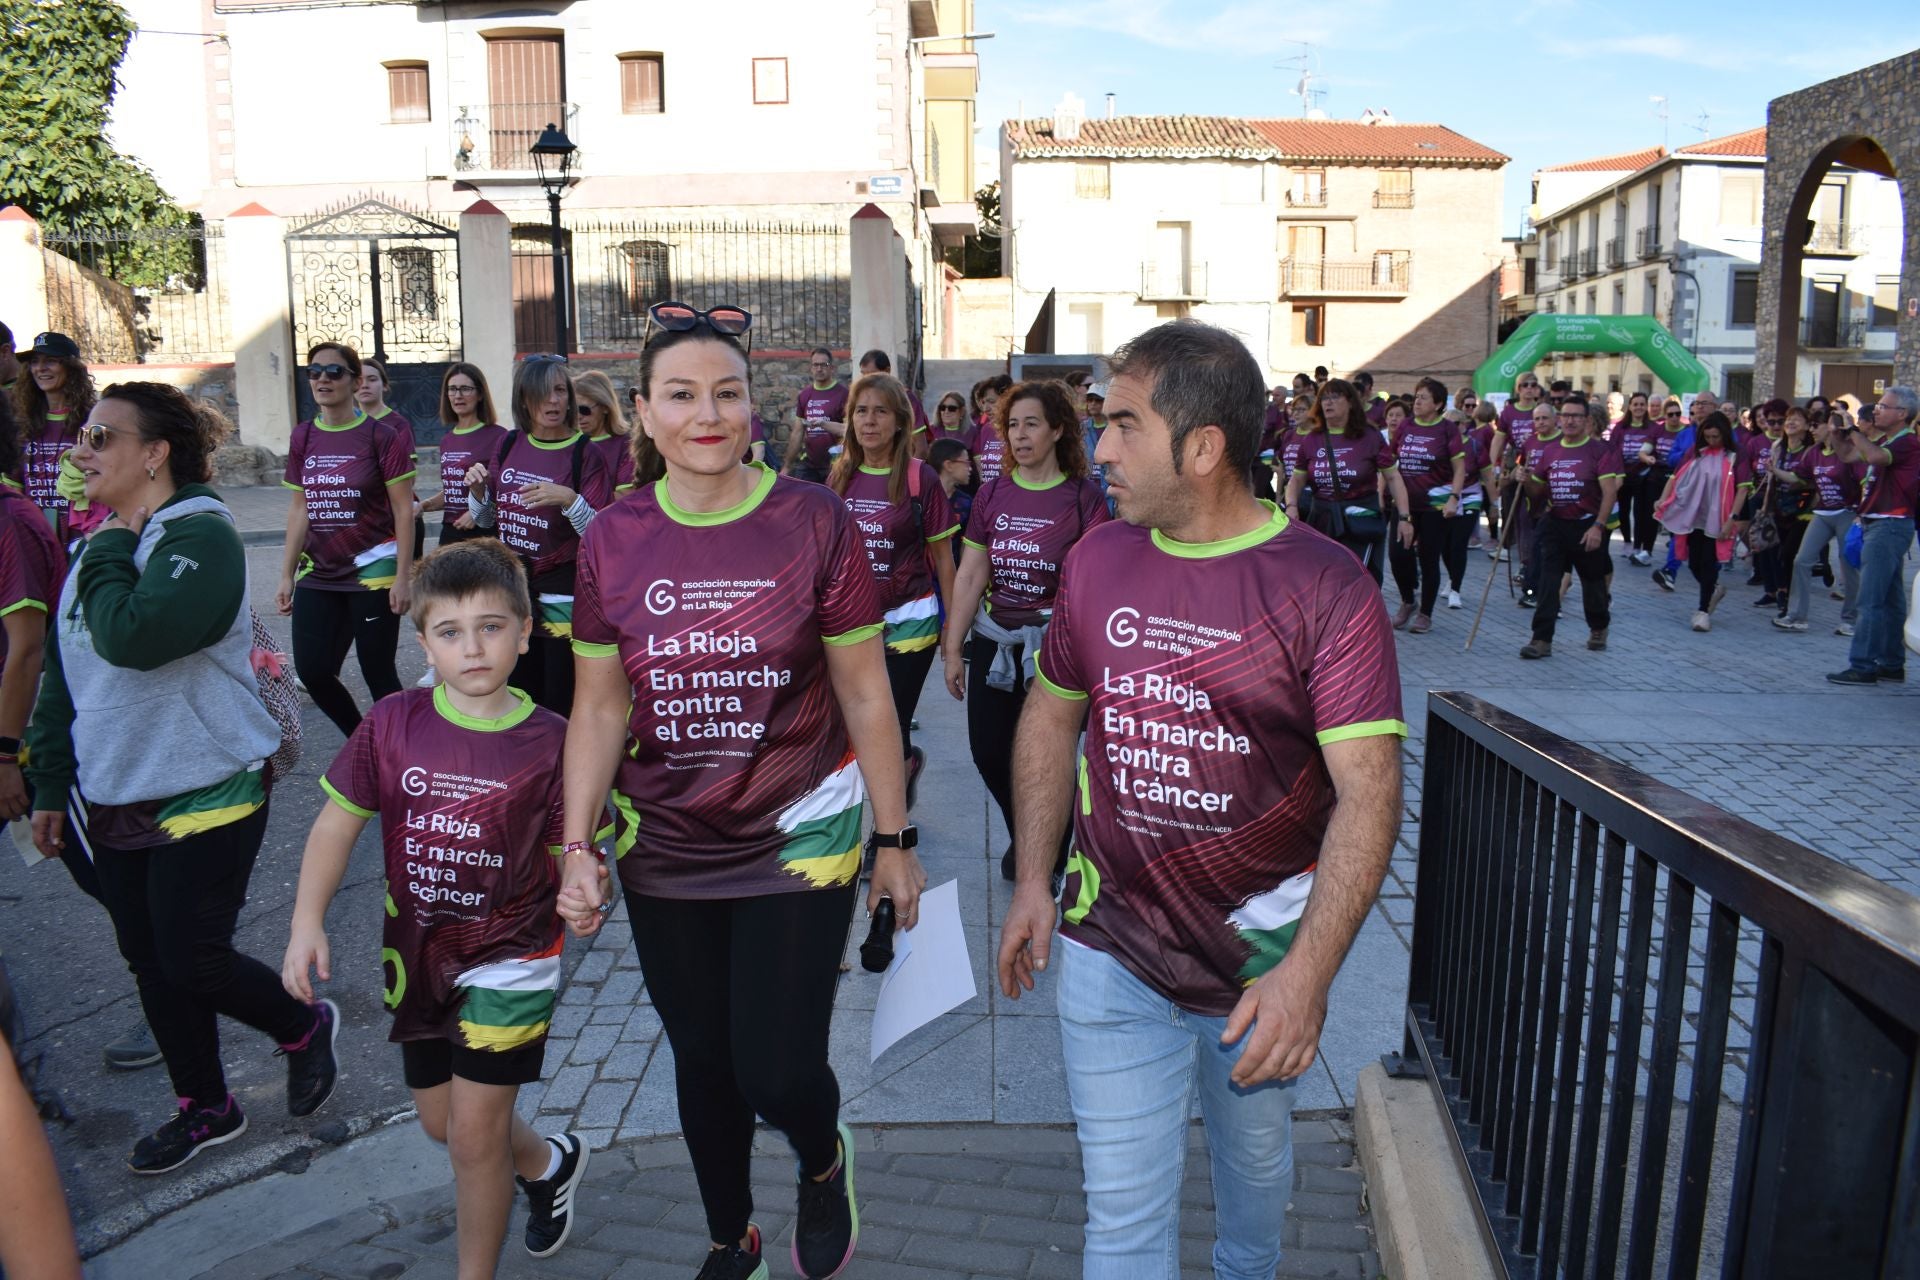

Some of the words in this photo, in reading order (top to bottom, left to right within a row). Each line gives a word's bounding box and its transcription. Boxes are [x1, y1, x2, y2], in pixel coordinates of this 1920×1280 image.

[303, 476, 314, 484] La
[318, 475, 345, 485] Rioja
[305, 489, 317, 498] En
[320, 488, 360, 498] marcha
[496, 491, 507, 502] La
[307, 500, 340, 509] contra
[309, 511, 317, 519] el
[320, 510, 355, 519] cáncer
[509, 511, 548, 529] marcha
[866, 539, 894, 549] archa
[992, 539, 1004, 550] La
[1008, 539, 1039, 554] Rioja
[872, 563, 889, 571] cer
[991, 555, 1003, 565] En
[1007, 557, 1056, 571] marcha
[682, 579, 730, 589] asociación
[733, 579, 775, 588] española
[1009, 580, 1046, 594] cáncer
[682, 591, 711, 599] contra
[714, 590, 722, 598] el
[724, 590, 756, 598] cáncer
[709, 601, 732, 611] Rioja
[1148, 616, 1195, 631] asociación
[1197, 626, 1241, 641] española
[648, 634, 681, 656] La
[689, 630, 757, 658] Rioja
[1145, 628, 1175, 639] contra
[1178, 633, 1186, 641] el
[1187, 635, 1218, 648] cáncer
[1143, 640, 1155, 648] en
[1158, 640, 1168, 650] La
[1170, 642, 1192, 657] Rioja
[650, 669, 683, 691] En
[693, 665, 791, 689] marcha
[1104, 667, 1134, 696] La
[1144, 673, 1211, 713] Rioja
[653, 693, 742, 717] contra
[655, 720, 680, 742] el
[686, 717, 766, 739] cánce
[1105, 706, 1135, 736] En
[1142, 719, 1250, 754] marcha
[1106, 743, 1190, 777] contra
[432, 781, 456, 789] contra
[465, 785, 490, 794] cáncer
[433, 772, 472, 782] asociación
[474, 778, 507, 789] española
[442, 790, 451, 798] La
[453, 791, 469, 800] Rioja
[1133, 776, 1233, 812] cáncer
[406, 810, 425, 830] La
[431, 814, 481, 839] Rioja
[1169, 820, 1195, 830] CONTRA
[428, 846, 504, 868] marcha
[407, 862, 457, 883] cntra
[419, 885, 485, 906] cáncer
